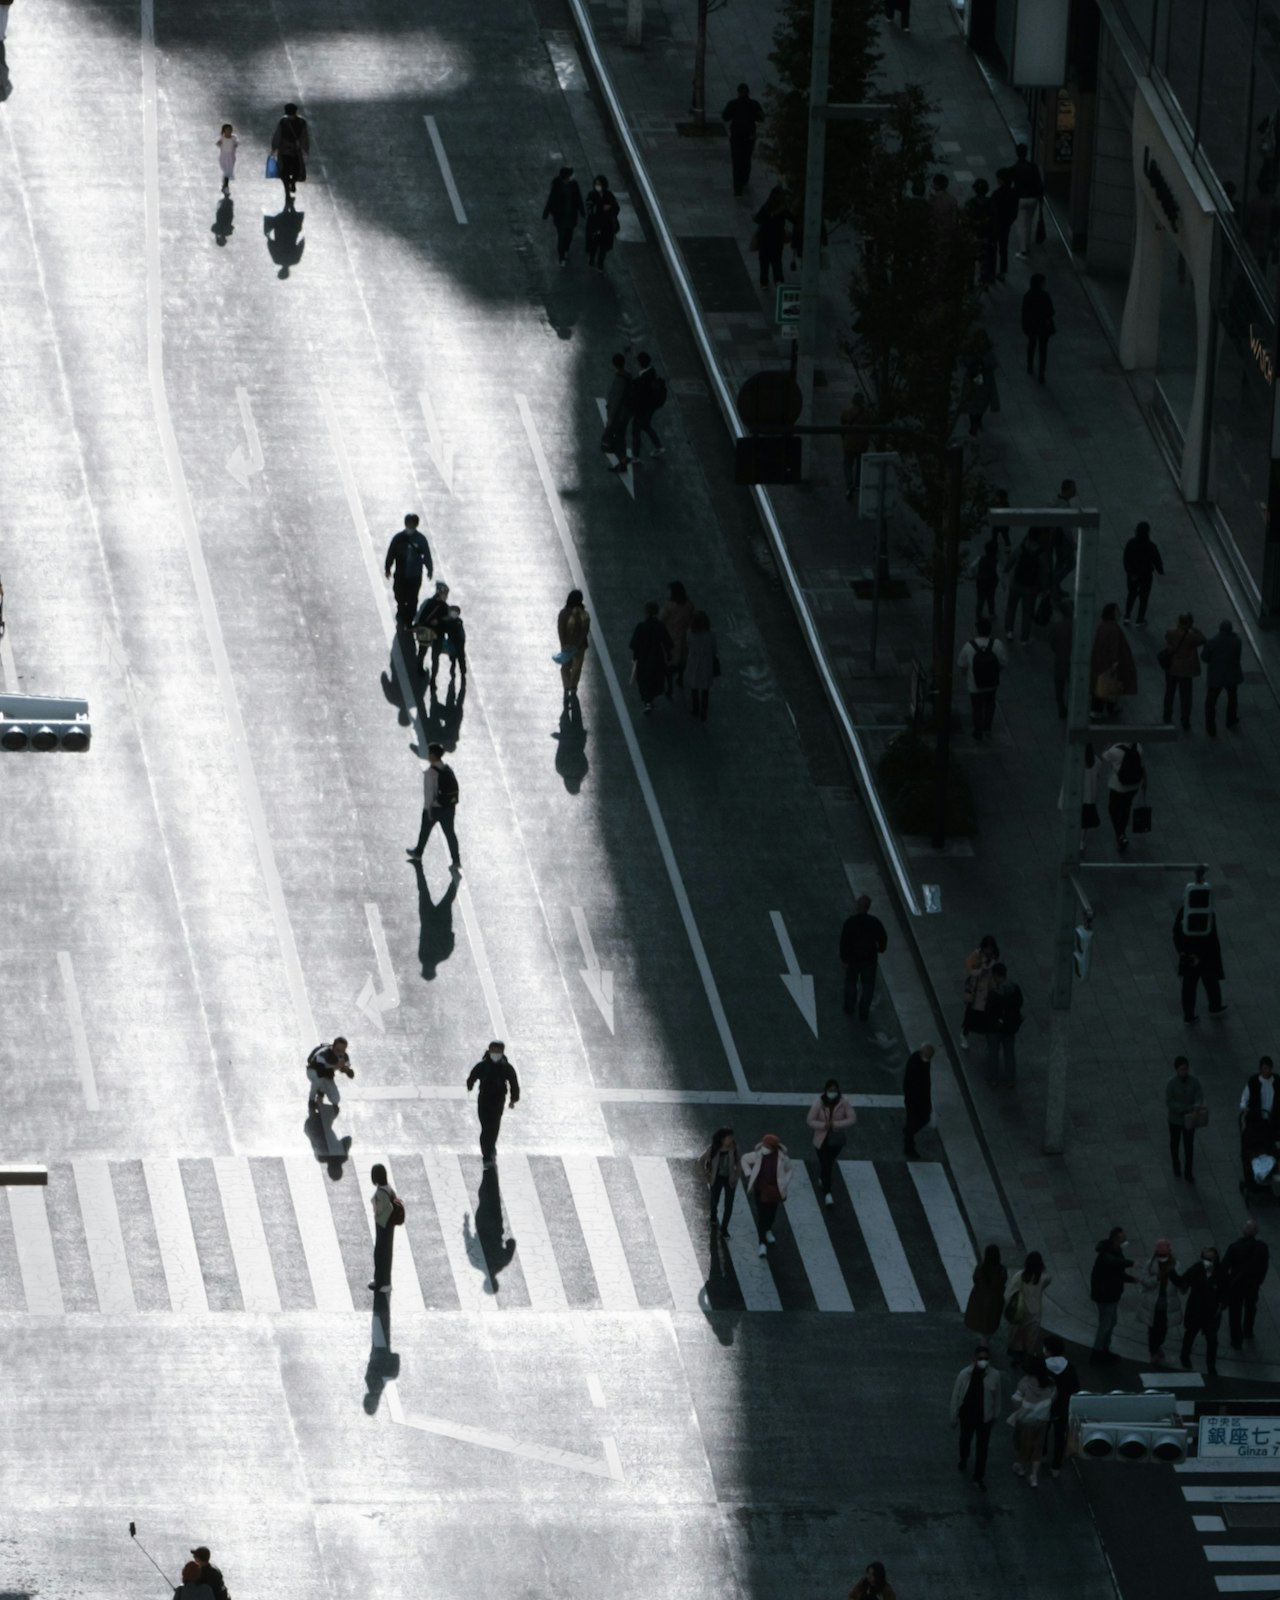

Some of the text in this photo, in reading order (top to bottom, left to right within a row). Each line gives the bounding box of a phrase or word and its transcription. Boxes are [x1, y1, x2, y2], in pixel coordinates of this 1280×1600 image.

[1207, 1417, 1242, 1428] 中央区
[1237, 1445, 1280, 1457] Ginza 7
